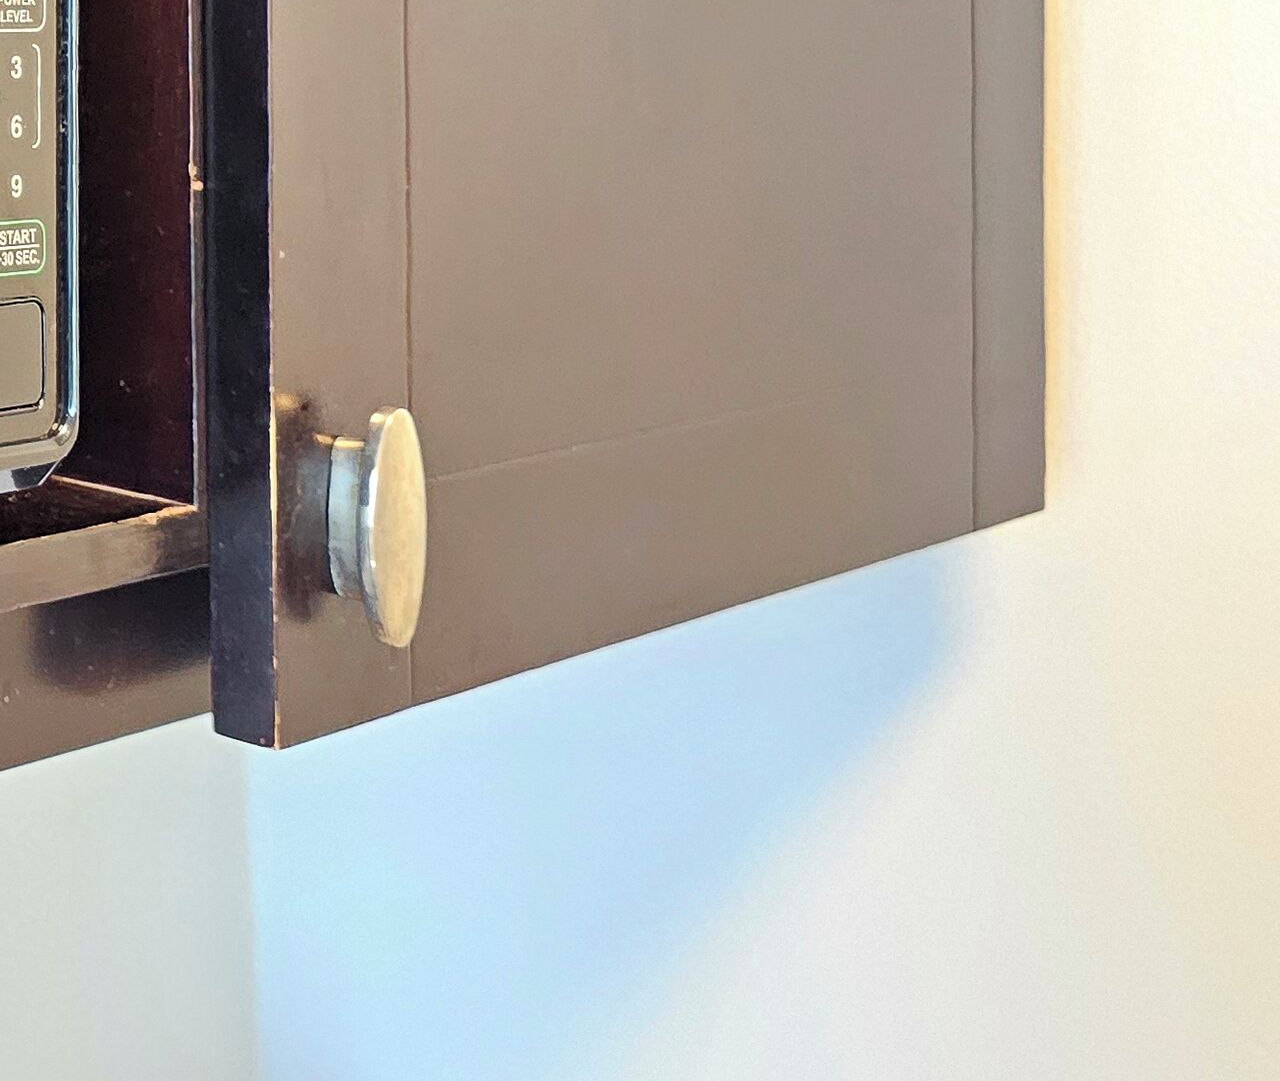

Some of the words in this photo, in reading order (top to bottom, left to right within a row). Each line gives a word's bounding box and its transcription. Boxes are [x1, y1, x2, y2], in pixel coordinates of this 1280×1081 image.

[0, 10, 33, 23] LEVEL
[10, 55, 23, 79] 3
[11, 115, 23, 139] 6
[11, 175, 23, 198] 9
[0, 228, 37, 245] START
[15, 250, 40, 265] SEC.
